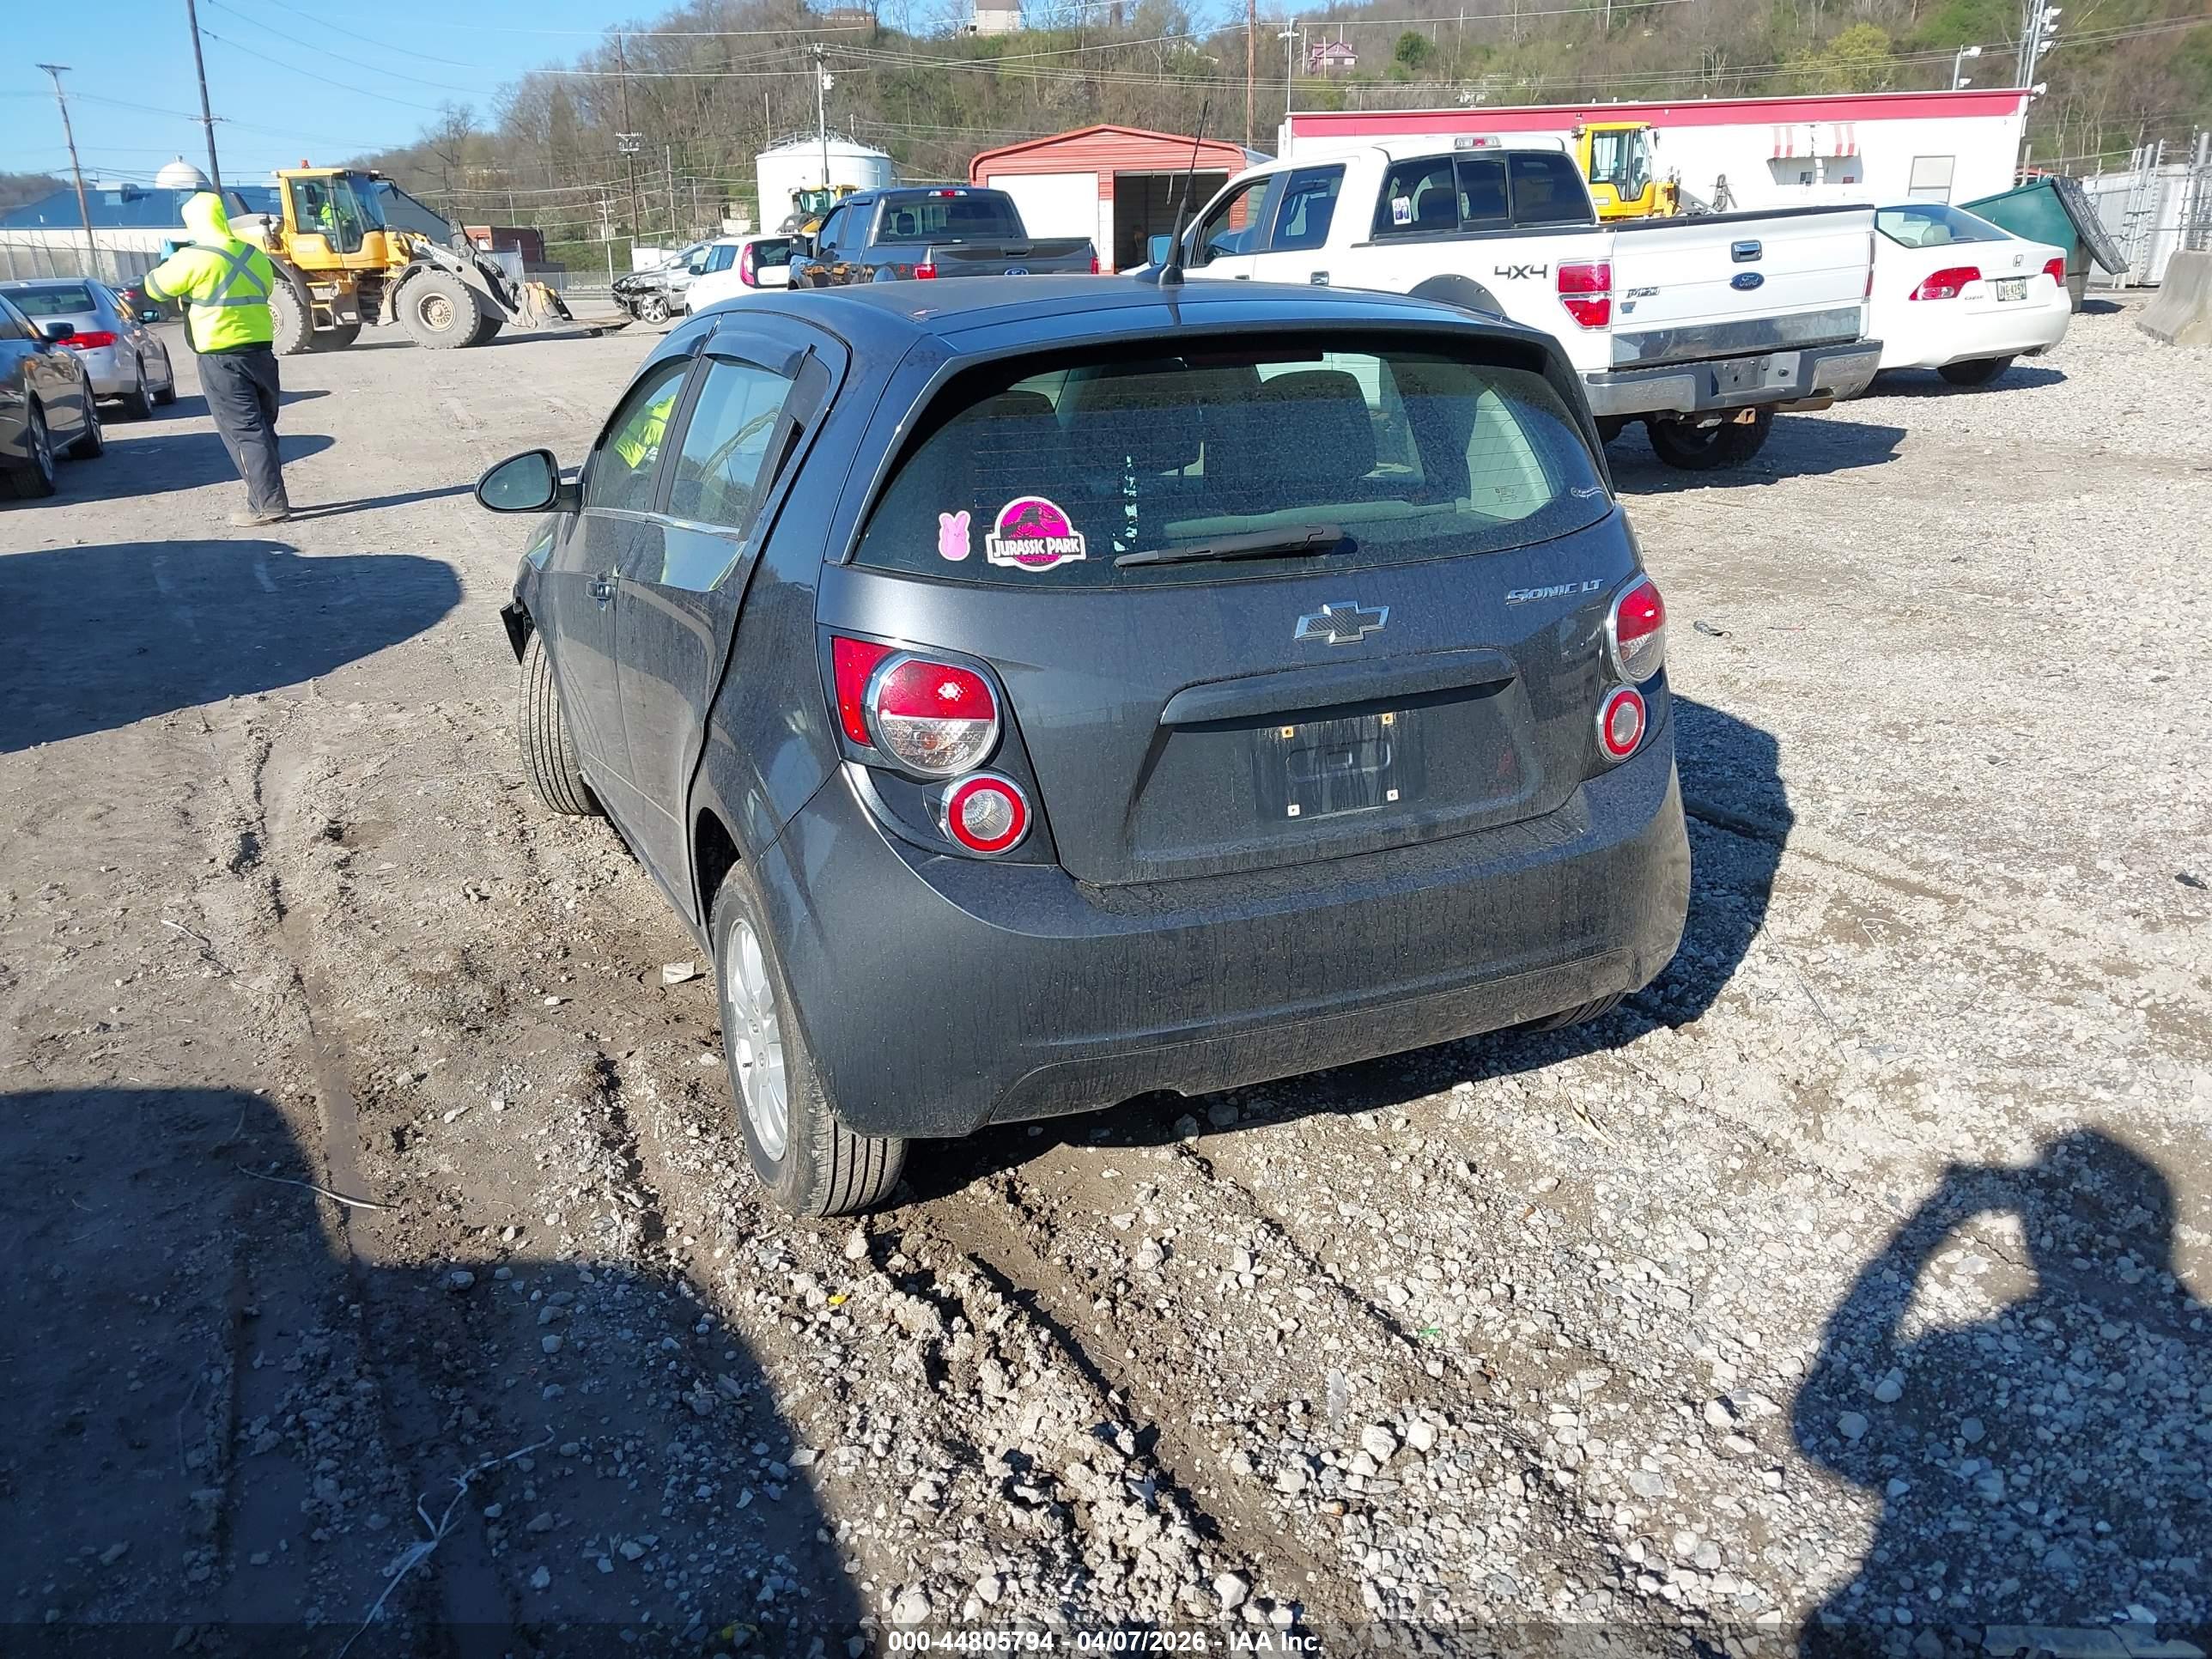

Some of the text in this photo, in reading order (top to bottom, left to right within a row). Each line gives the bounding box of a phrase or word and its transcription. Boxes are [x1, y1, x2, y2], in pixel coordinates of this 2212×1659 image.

[994, 537, 1080, 557] JURASSIC PARK
[1506, 579, 1603, 605] SONIC LT
